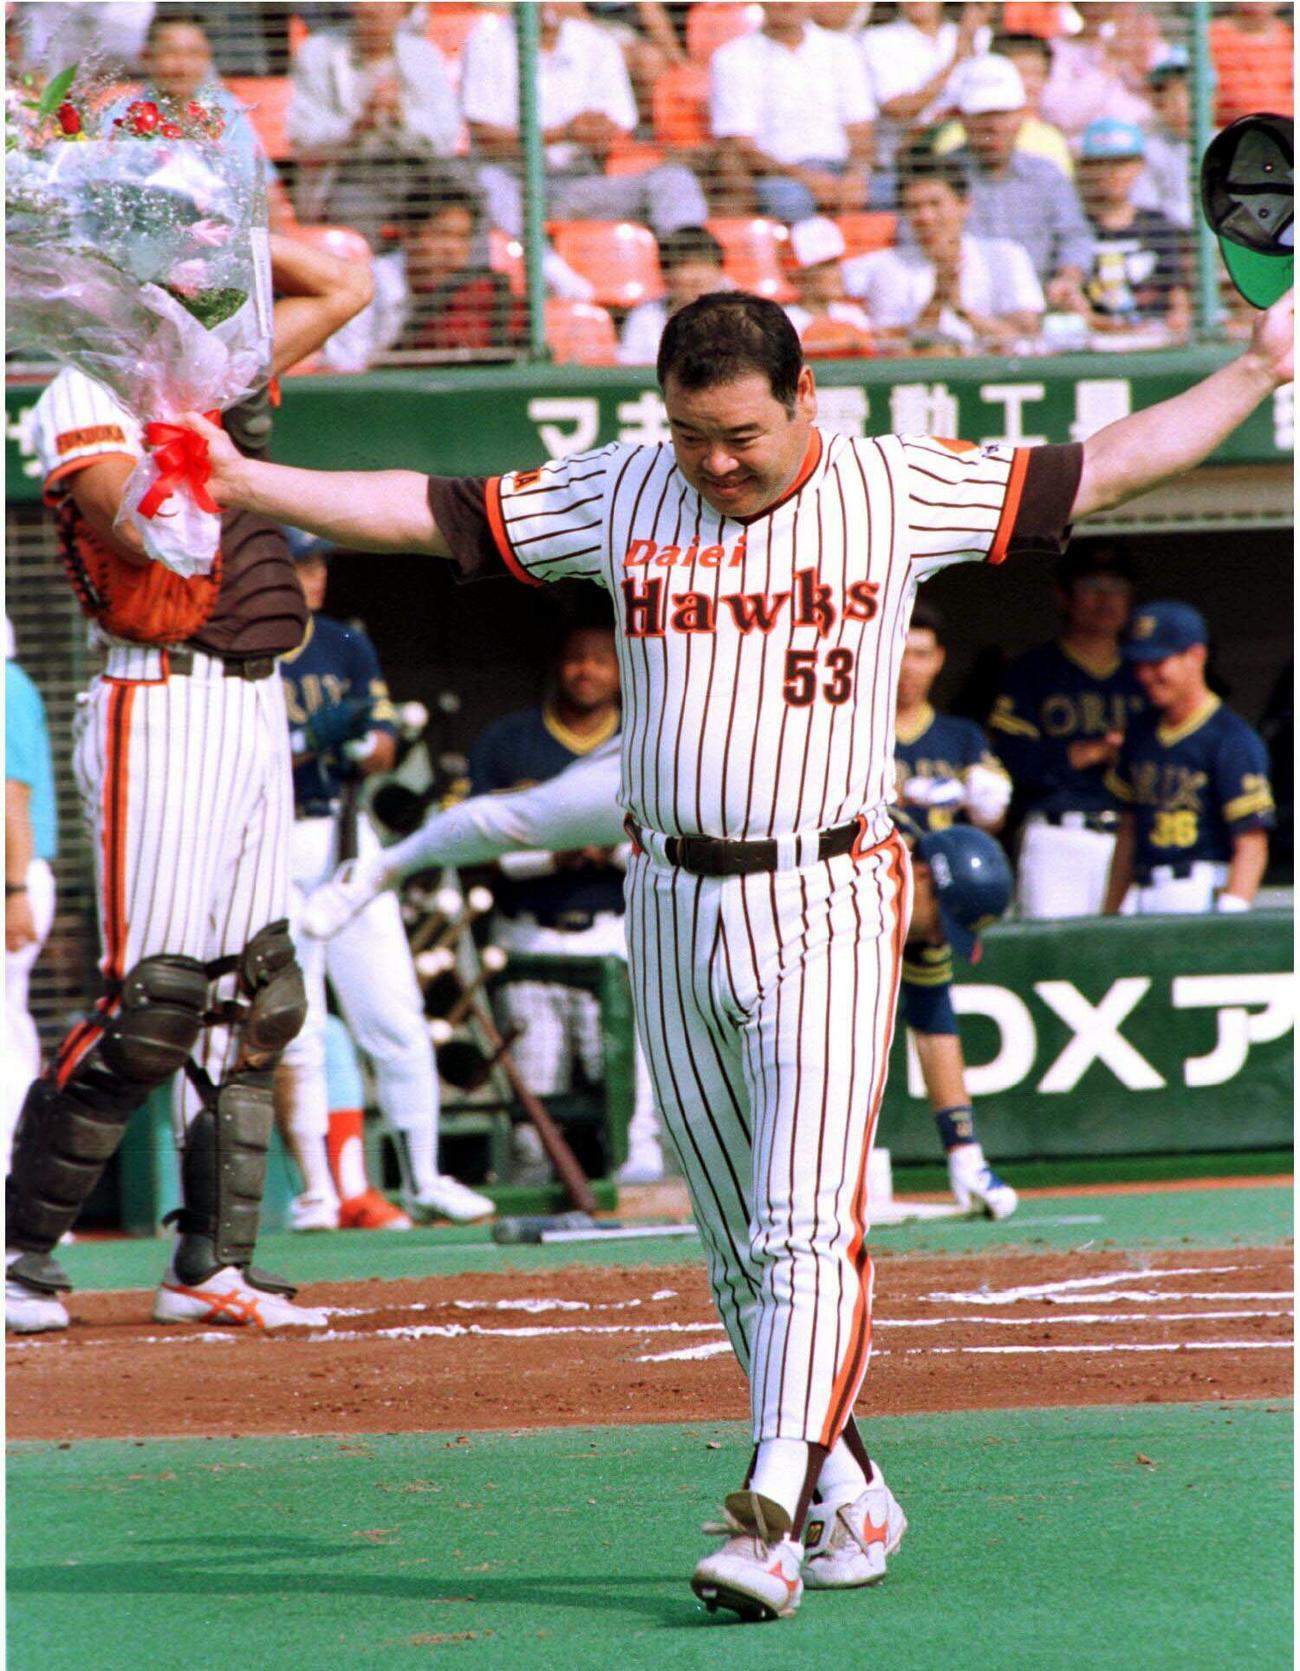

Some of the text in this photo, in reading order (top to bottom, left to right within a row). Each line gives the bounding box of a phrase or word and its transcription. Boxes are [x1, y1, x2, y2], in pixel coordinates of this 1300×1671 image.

[623, 535, 747, 568] Daiei
[621, 566, 880, 639] Hawks
[783, 646, 855, 708] 53
